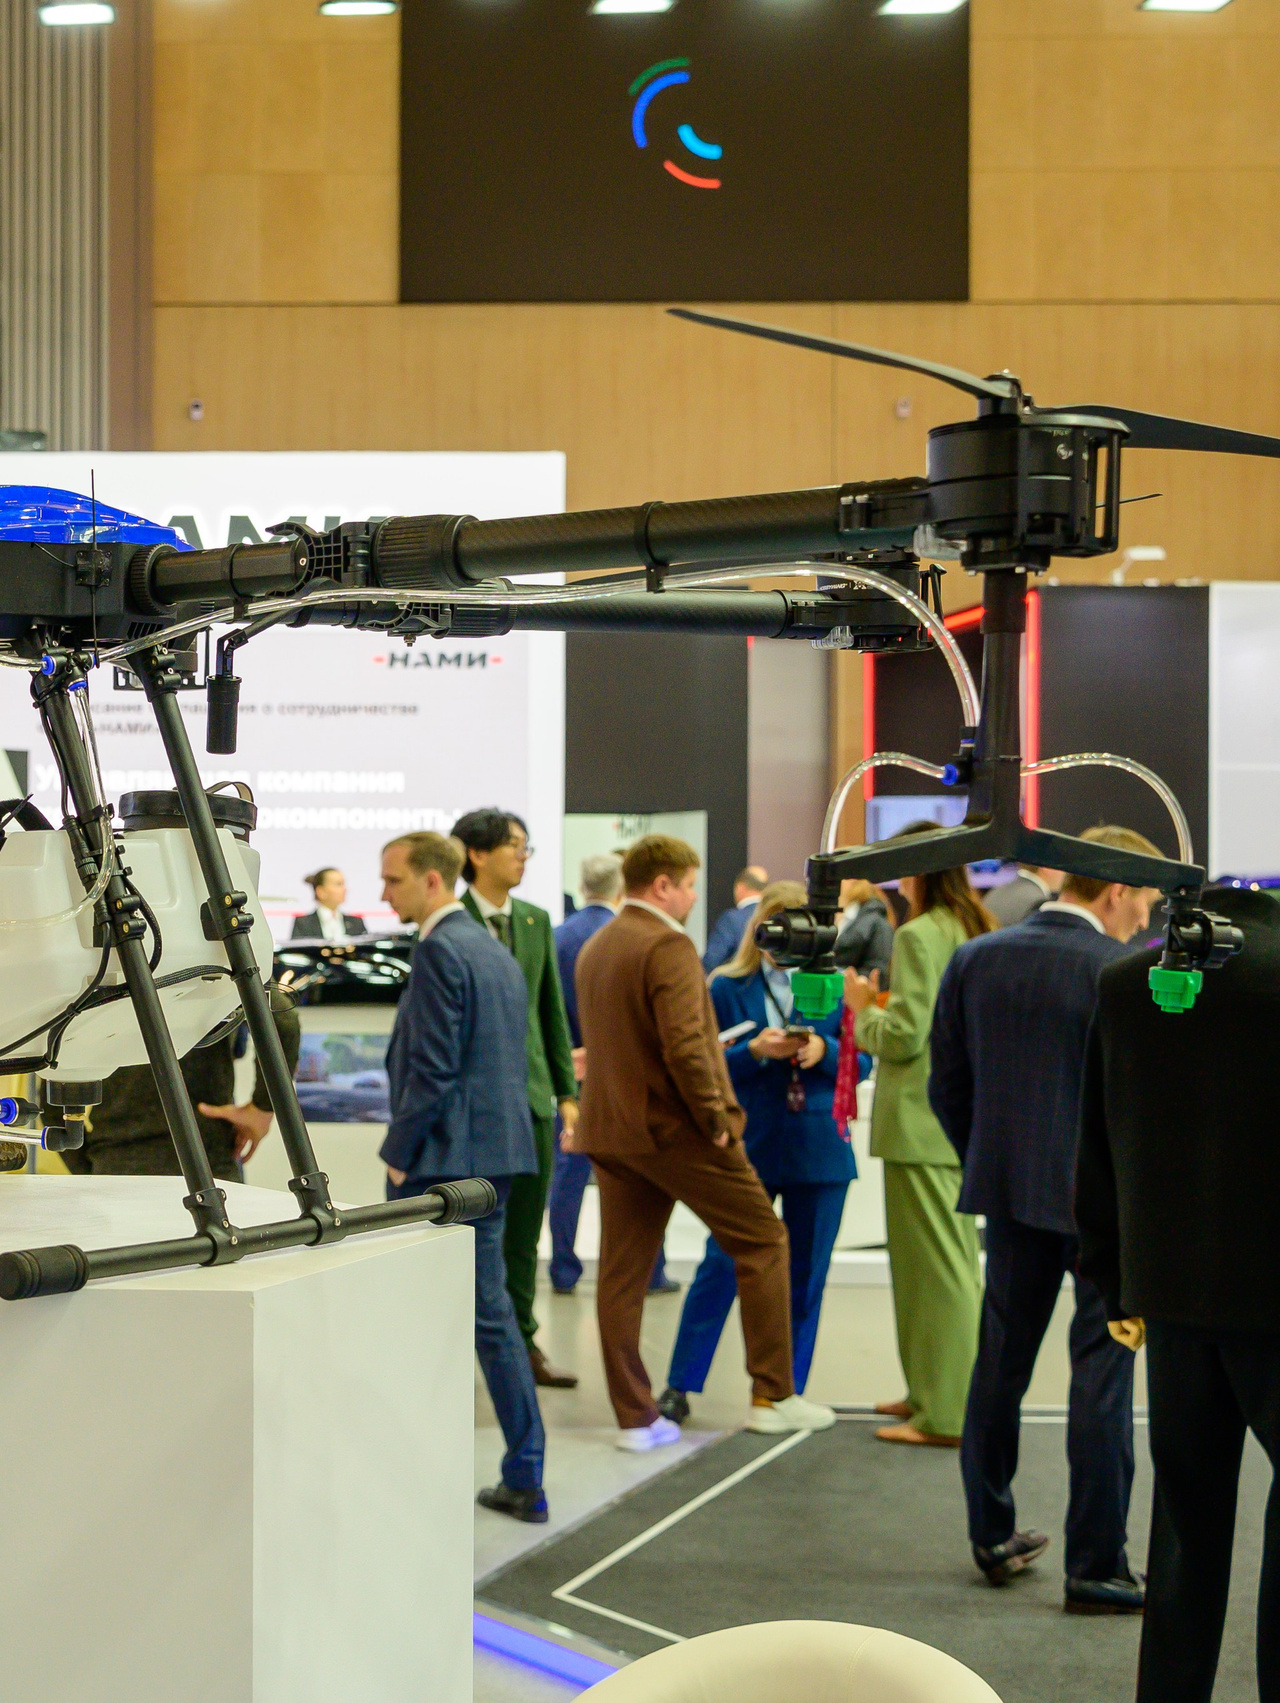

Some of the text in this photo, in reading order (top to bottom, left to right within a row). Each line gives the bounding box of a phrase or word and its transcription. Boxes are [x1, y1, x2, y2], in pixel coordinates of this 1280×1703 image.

[389, 652, 488, 669] НАМИ
[278, 703, 418, 718] сотрудничестве
[257, 771, 406, 794] компания
